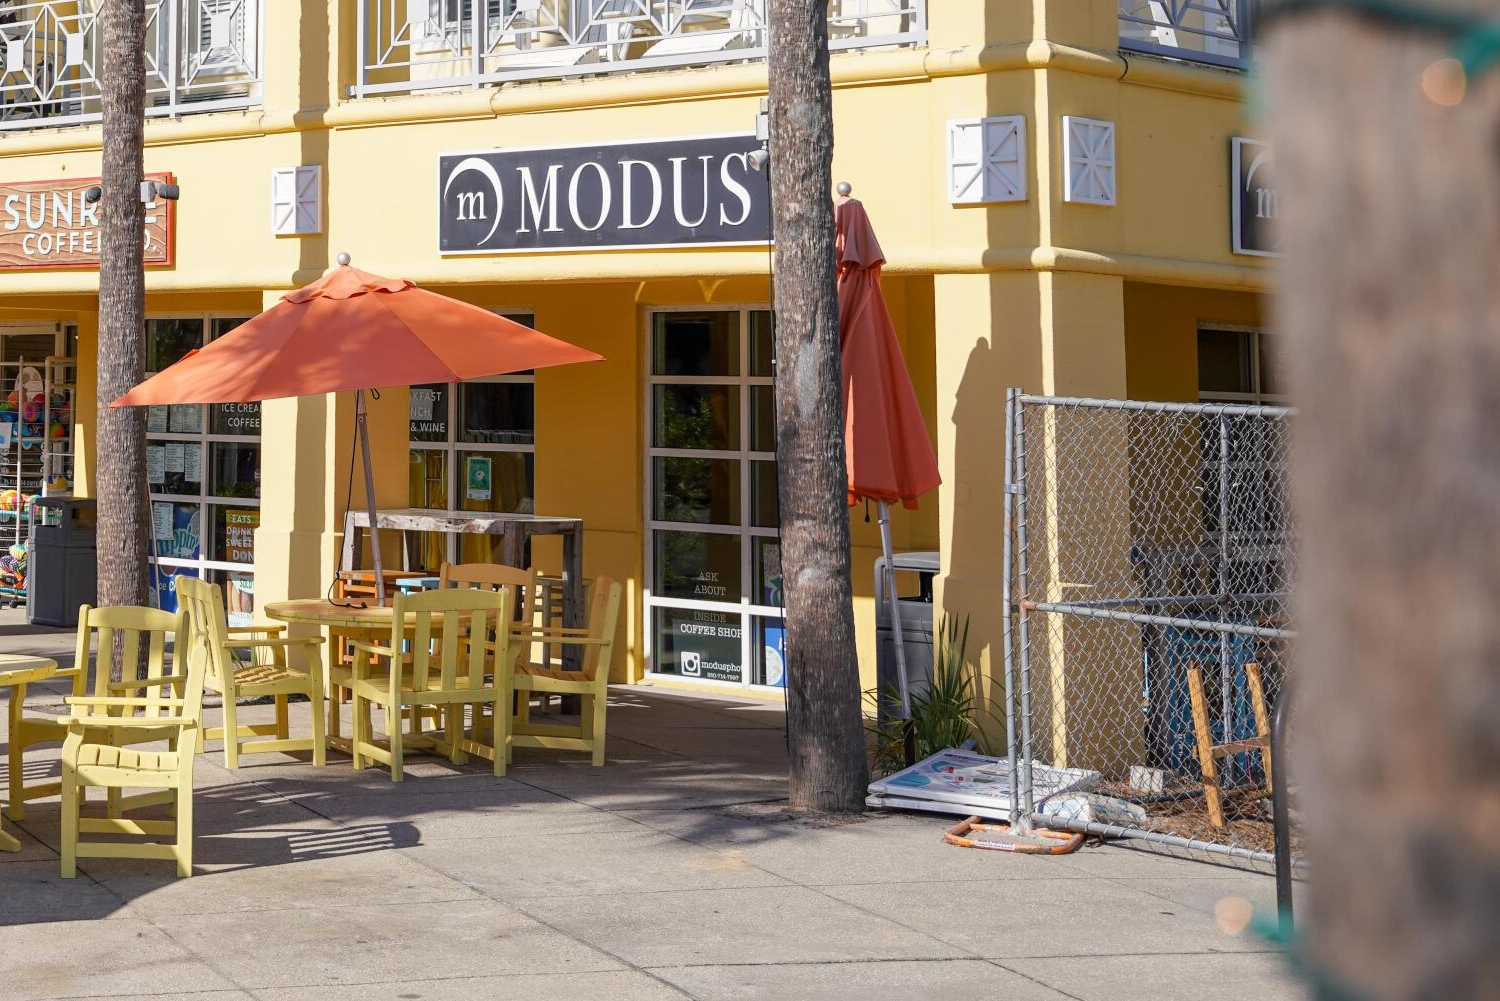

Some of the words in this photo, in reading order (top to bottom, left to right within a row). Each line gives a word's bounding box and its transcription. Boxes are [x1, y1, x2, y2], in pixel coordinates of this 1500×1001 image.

[515, 151, 753, 234] MODUS
[21, 230, 102, 256] COFFE
[221, 403, 235, 413] ICE
[237, 403, 262, 413] CREA
[227, 417, 260, 428] COFFEE
[410, 422, 418, 432] &
[419, 422, 445, 433] WINE
[231, 514, 251, 524] EATS
[699, 572, 718, 582] ASK
[694, 585, 726, 596] ABOUT
[694, 612, 726, 623] INSIDE
[680, 624, 715, 636] COFFEE
